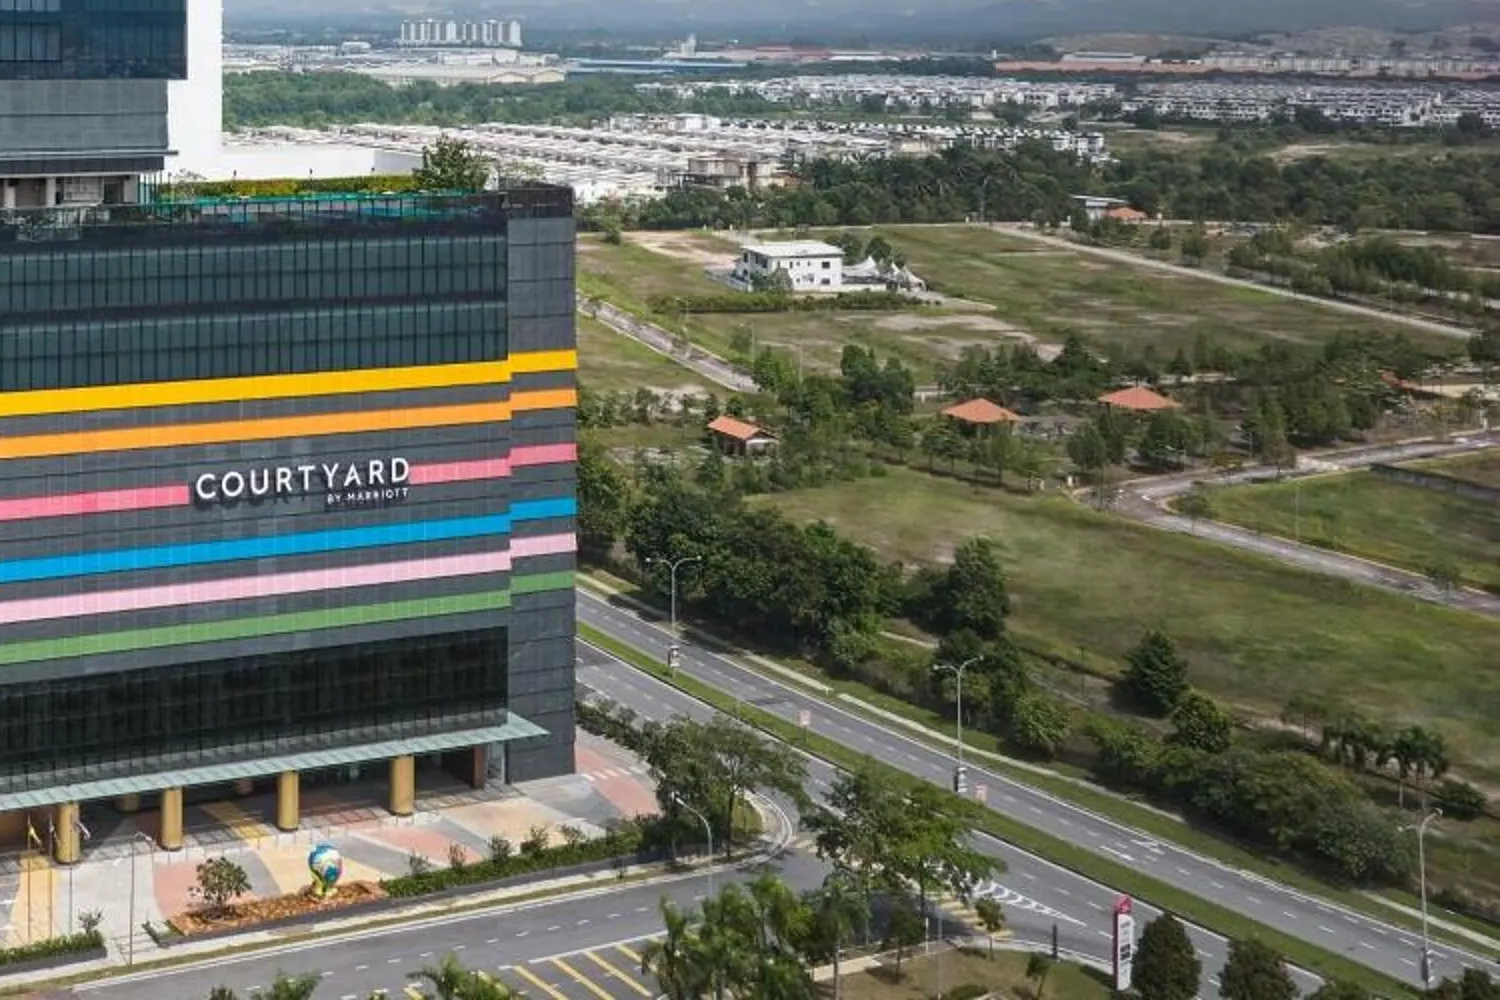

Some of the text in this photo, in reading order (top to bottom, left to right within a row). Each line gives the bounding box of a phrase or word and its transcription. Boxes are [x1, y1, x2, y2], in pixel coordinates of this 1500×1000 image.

[196, 457, 409, 499] COURTYARD
[327, 487, 409, 505] BY MARRIOTT
